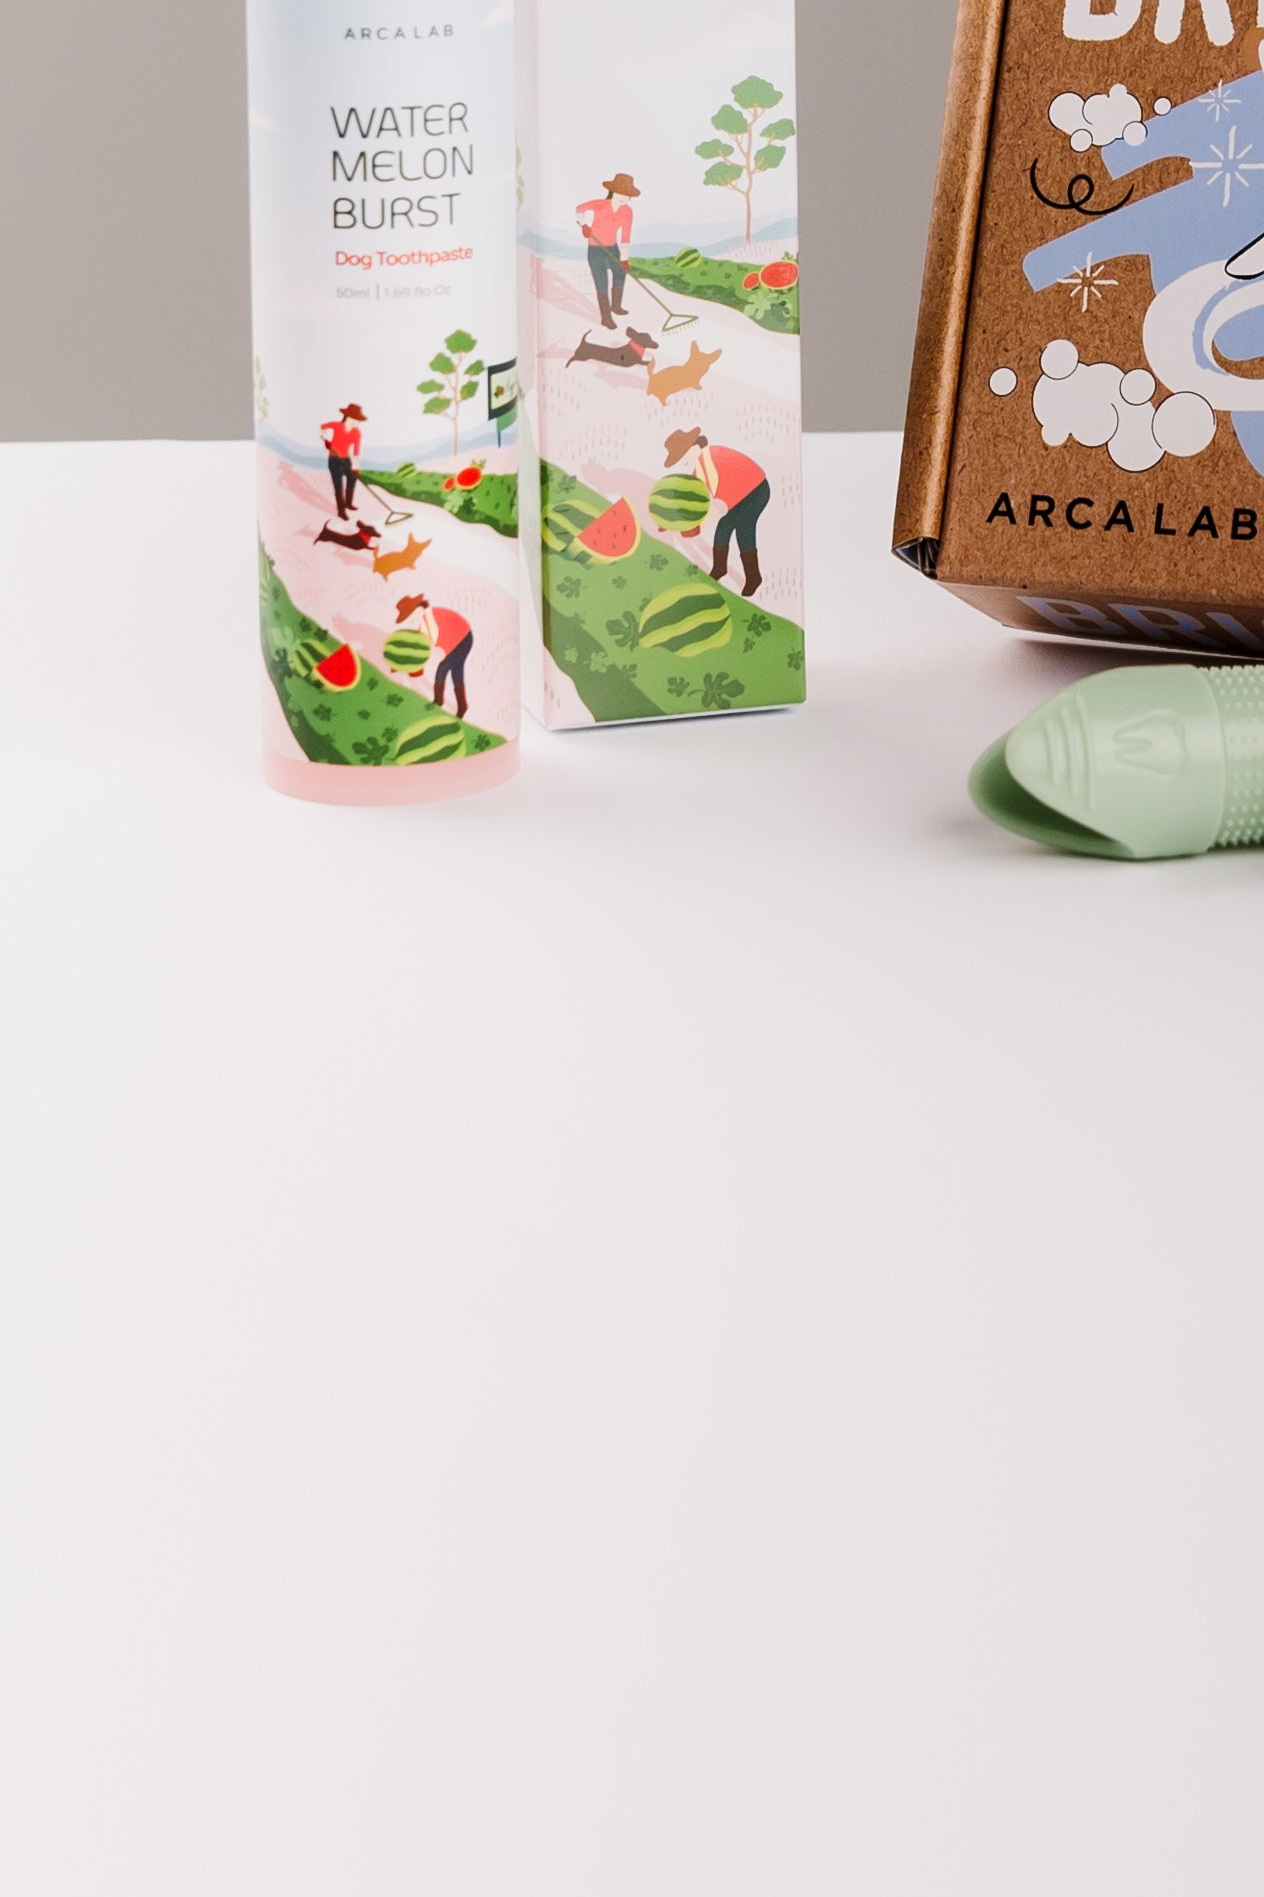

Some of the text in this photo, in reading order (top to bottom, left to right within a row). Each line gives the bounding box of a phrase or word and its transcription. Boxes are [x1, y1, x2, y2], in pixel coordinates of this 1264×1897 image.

[330, 102, 469, 138] WATER
[331, 144, 474, 182] MELON
[332, 192, 462, 230] BURST
[335, 246, 474, 270] Dog Toothpaste
